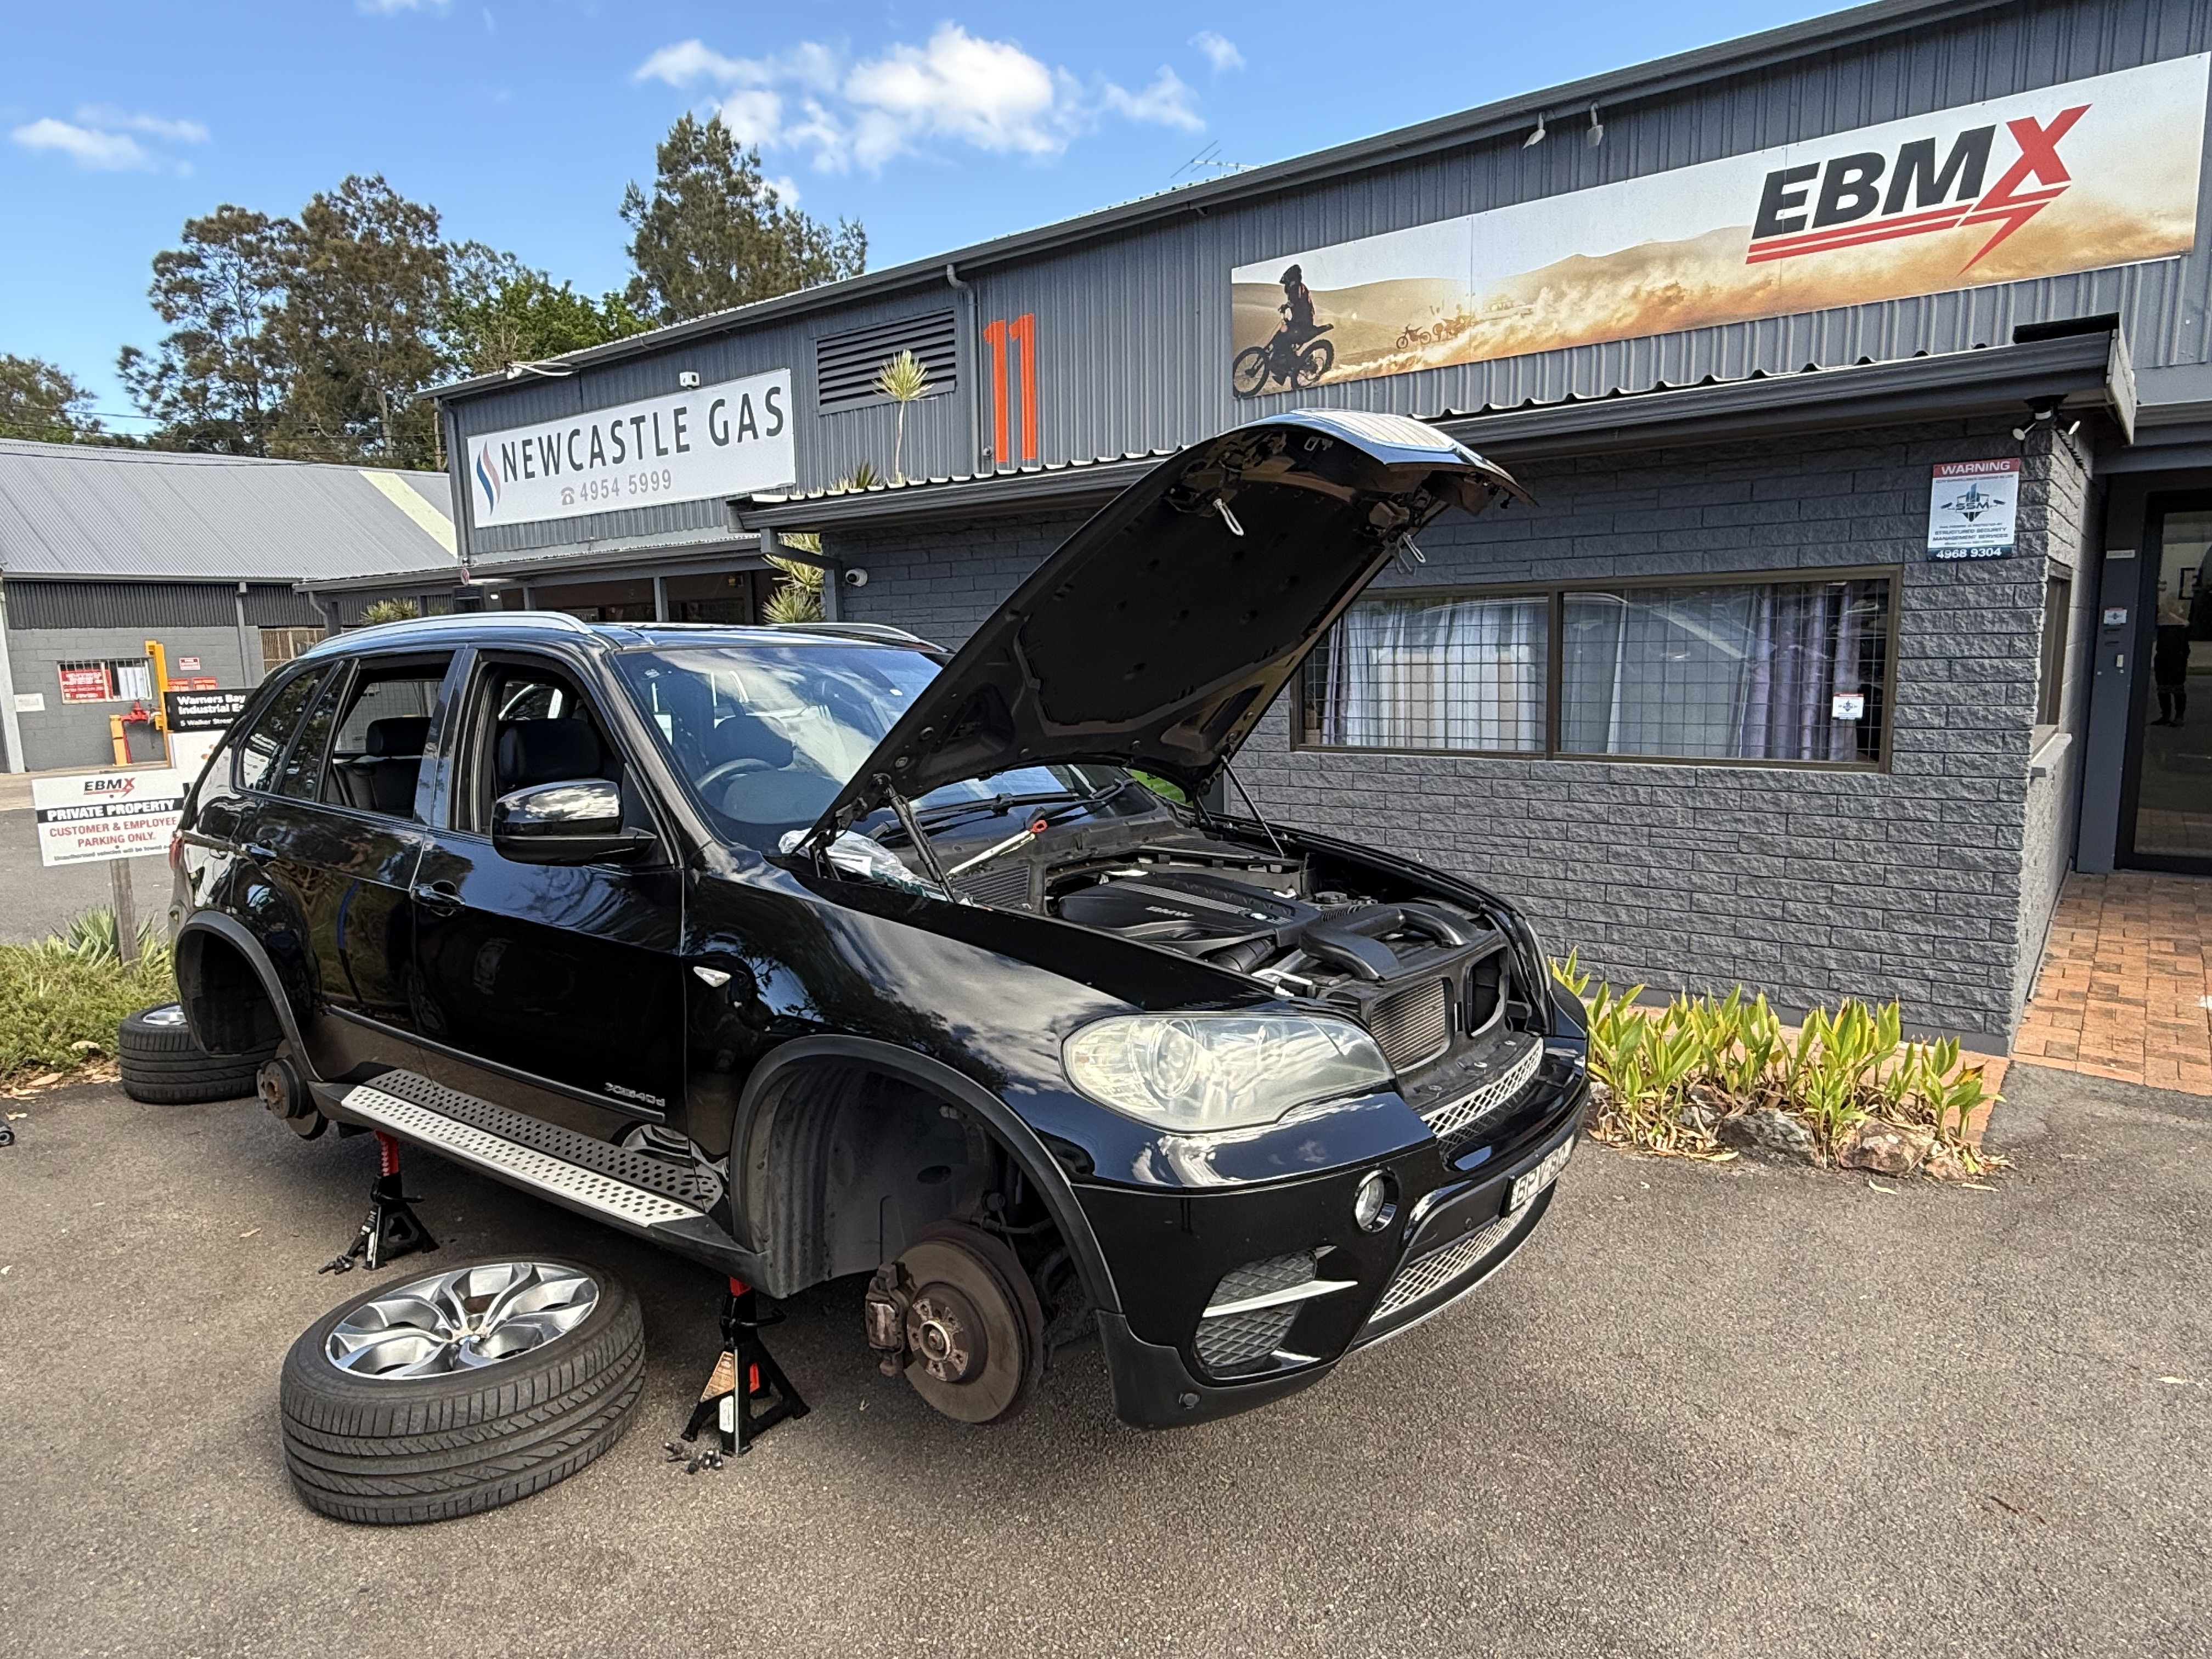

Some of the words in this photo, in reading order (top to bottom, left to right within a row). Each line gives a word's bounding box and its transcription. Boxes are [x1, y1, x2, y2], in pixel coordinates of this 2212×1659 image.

[1750, 103, 2092, 241] EBMX
[983, 313, 1037, 463] 11
[501, 406, 691, 483] NEWCASTLE
[708, 386, 785, 447] GAS
[1941, 461, 2010, 475] WARNING
[580, 478, 620, 502] 4954
[628, 469, 673, 494] 5999
[1936, 549, 1967, 558] 4968
[1970, 548, 2002, 557] 9304
[177, 696, 224, 706] Warners
[225, 694, 246, 703] Bay
[178, 704, 230, 714] Industrial
[84, 777, 136, 792] EBMX
[47, 805, 104, 821] PRIVATE
[106, 799, 174, 815] PROPERTY
[49, 823, 110, 837] CUSTOMER
[113, 822, 121, 831] &
[123, 816, 177, 830] EMPLOYEE
[77, 834, 125, 848] PARKING
